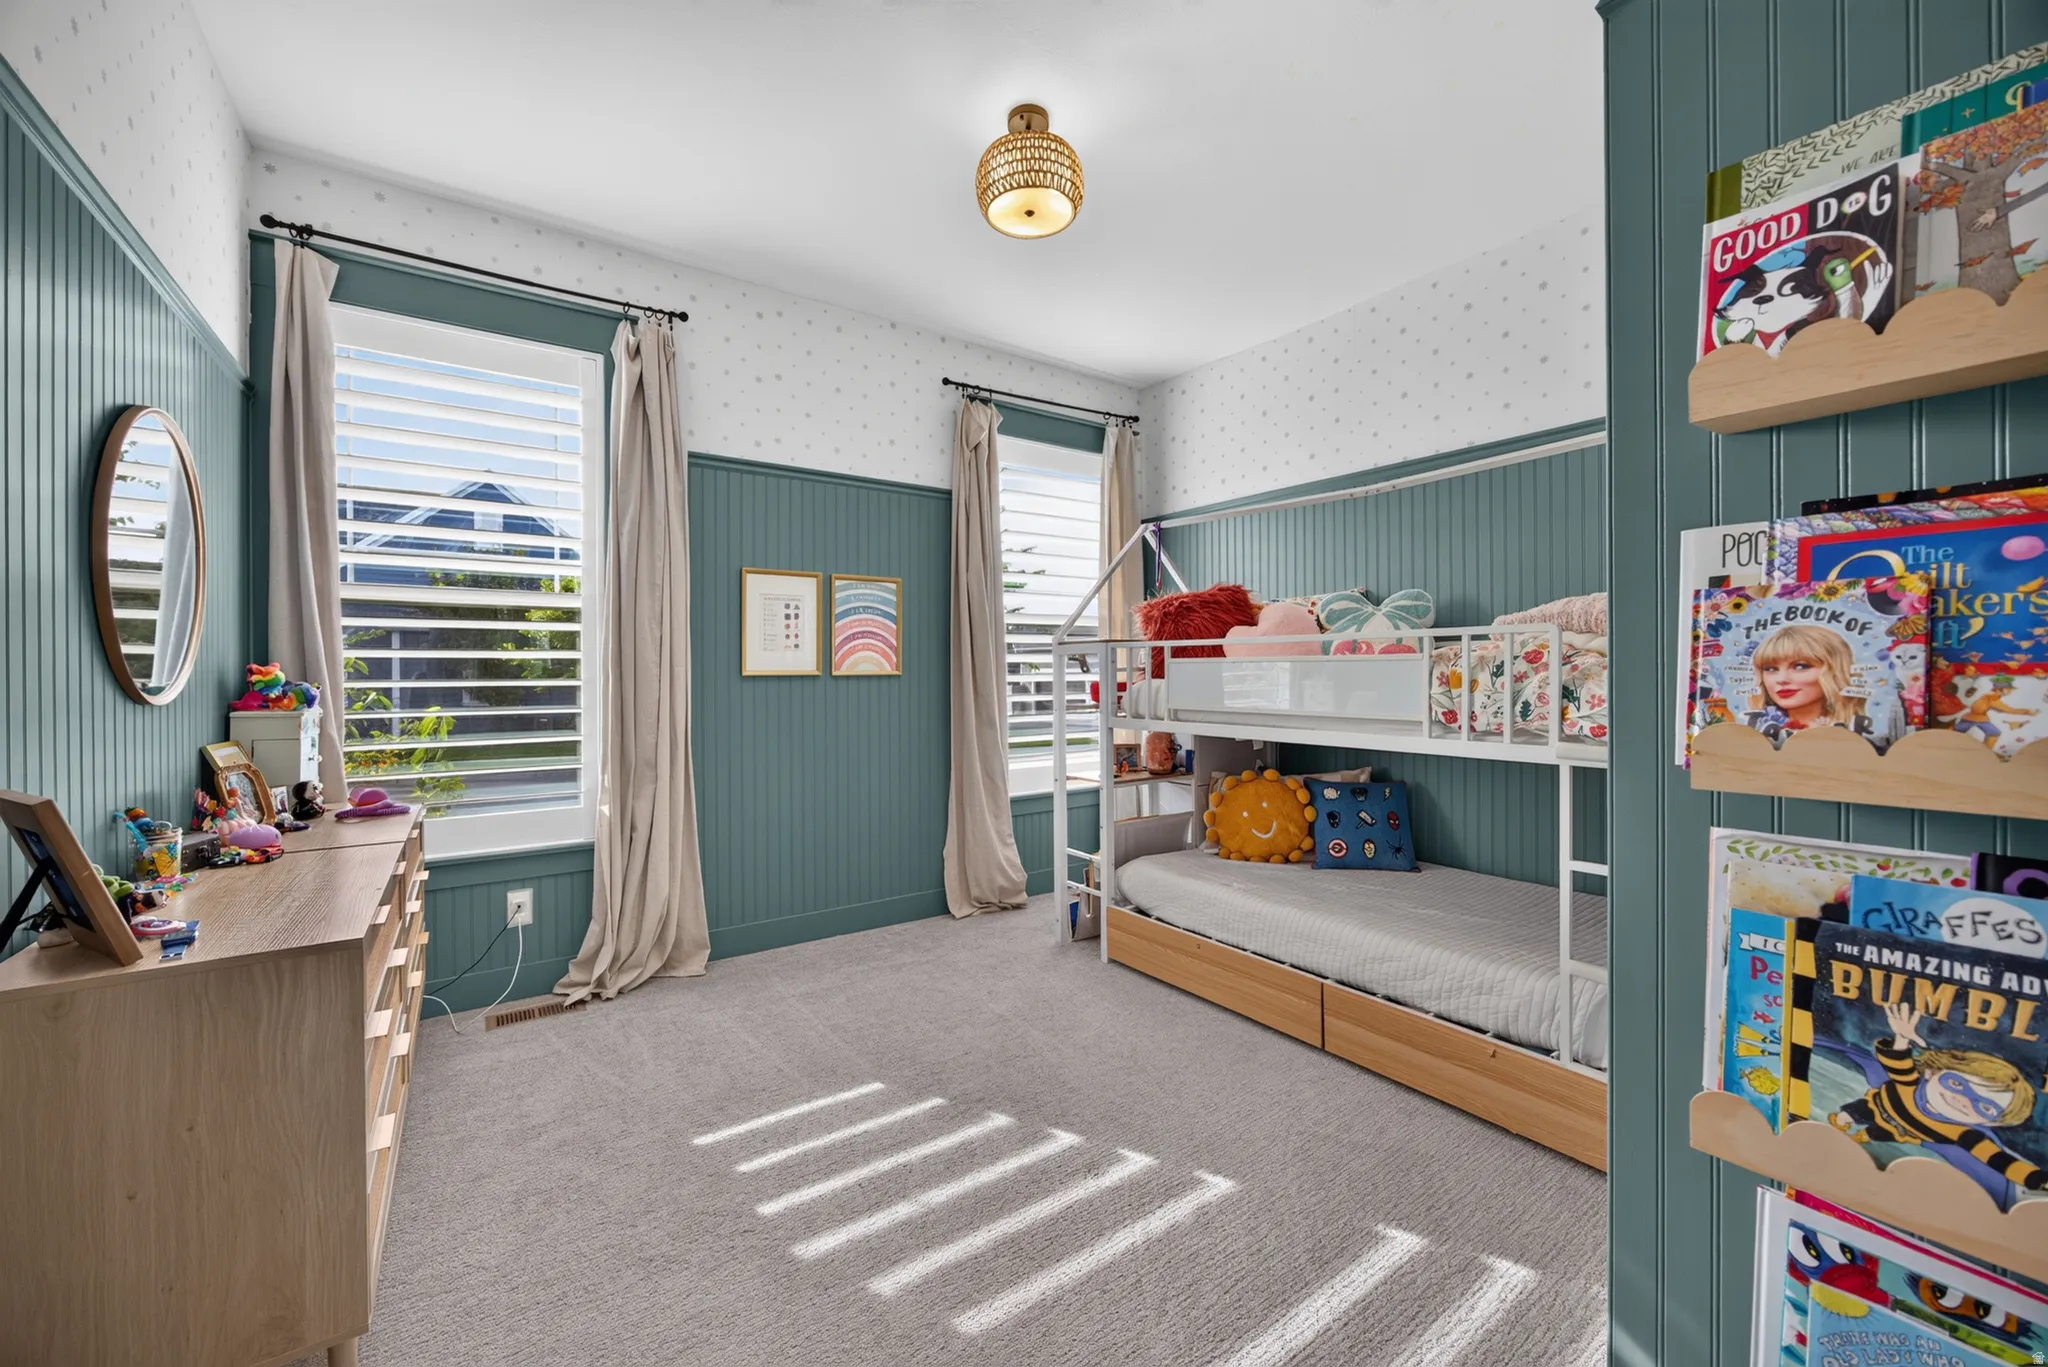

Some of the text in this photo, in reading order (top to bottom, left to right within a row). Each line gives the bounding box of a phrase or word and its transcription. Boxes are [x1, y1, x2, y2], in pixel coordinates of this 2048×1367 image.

[1841, 156, 1864, 174] WE
[1712, 174, 1892, 273] GOOD DOG
[1901, 545, 1954, 565] The
[1742, 605, 1873, 640] THE BOOK OF
[1862, 901, 2043, 945] GIRAFFES
[1750, 955, 1783, 985] Pe
[1835, 942, 2048, 996] THE AMAZING AD
[1829, 959, 2041, 1043] BUMBL
